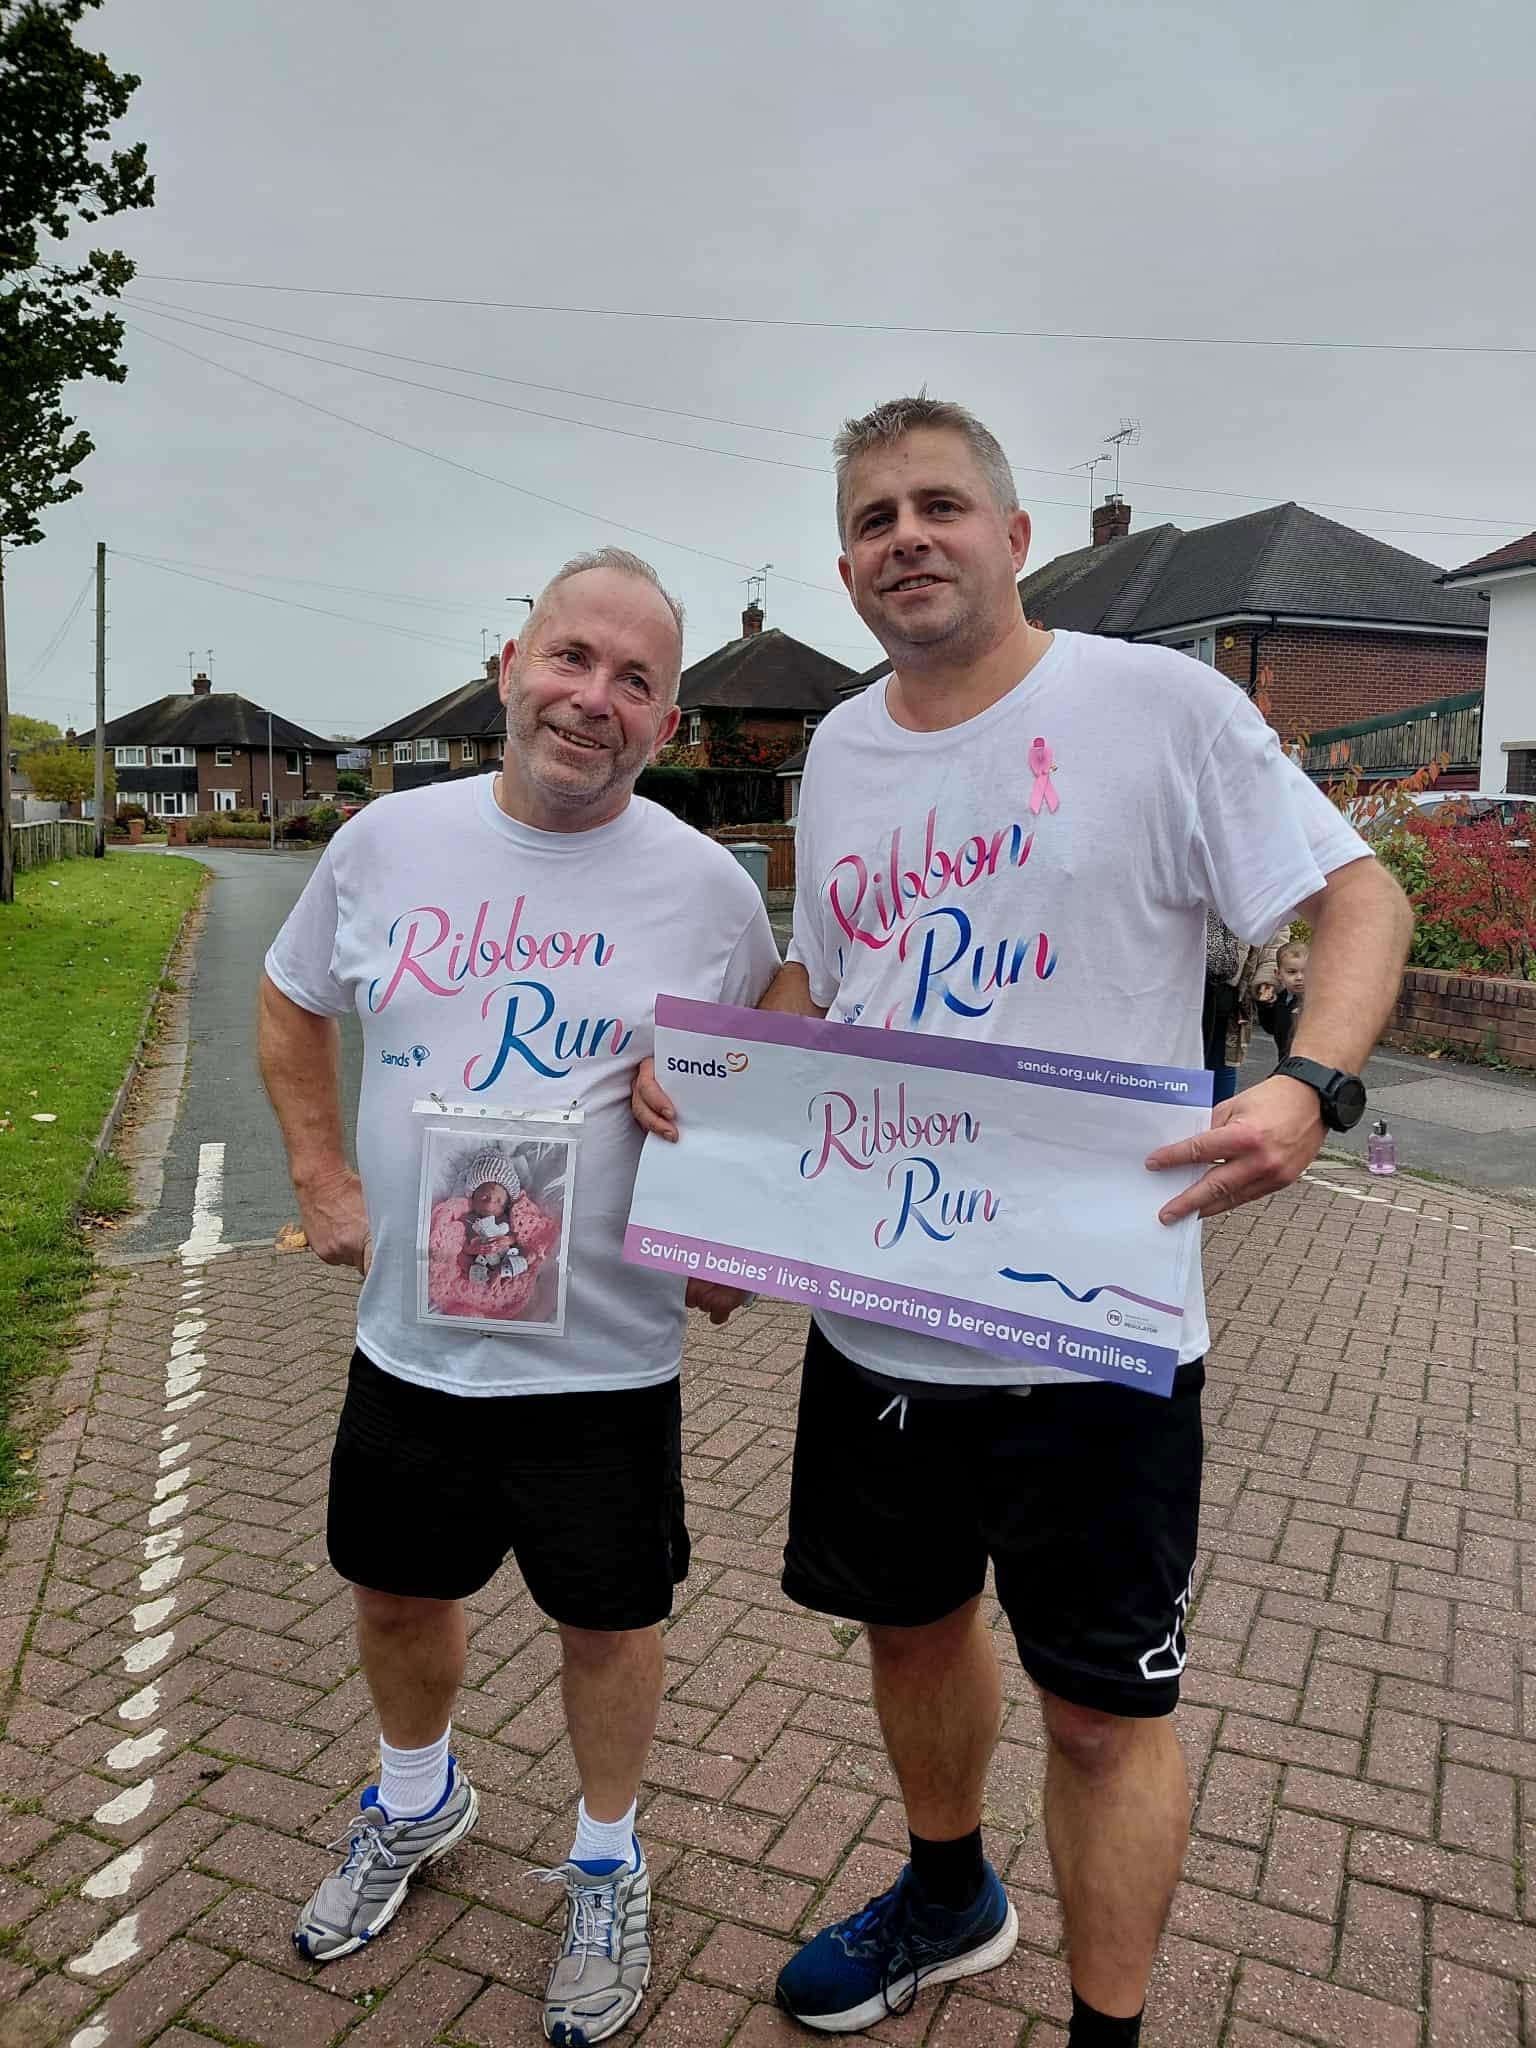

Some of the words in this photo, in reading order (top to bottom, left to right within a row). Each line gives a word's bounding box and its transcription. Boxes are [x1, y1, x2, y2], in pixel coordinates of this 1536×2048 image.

[820, 803, 1035, 977] Ribbon
[368, 894, 616, 1015] Ribbon
[884, 906, 1058, 1030] Run
[381, 1049, 410, 1067] Sands
[463, 980, 633, 1092] Run
[667, 1055, 728, 1079] sands
[1016, 1059, 1189, 1093] sands.org.uk/ribbon-run
[799, 1081, 981, 1180] Ribbon
[874, 1156, 1001, 1250] Run
[639, 1236, 701, 1269] Saving
[704, 1251, 774, 1281] babies'
[776, 1267, 822, 1295] lives.
[828, 1279, 942, 1327] Supporting
[947, 1307, 1051, 1351] bereaved
[1056, 1335, 1153, 1376] families.
